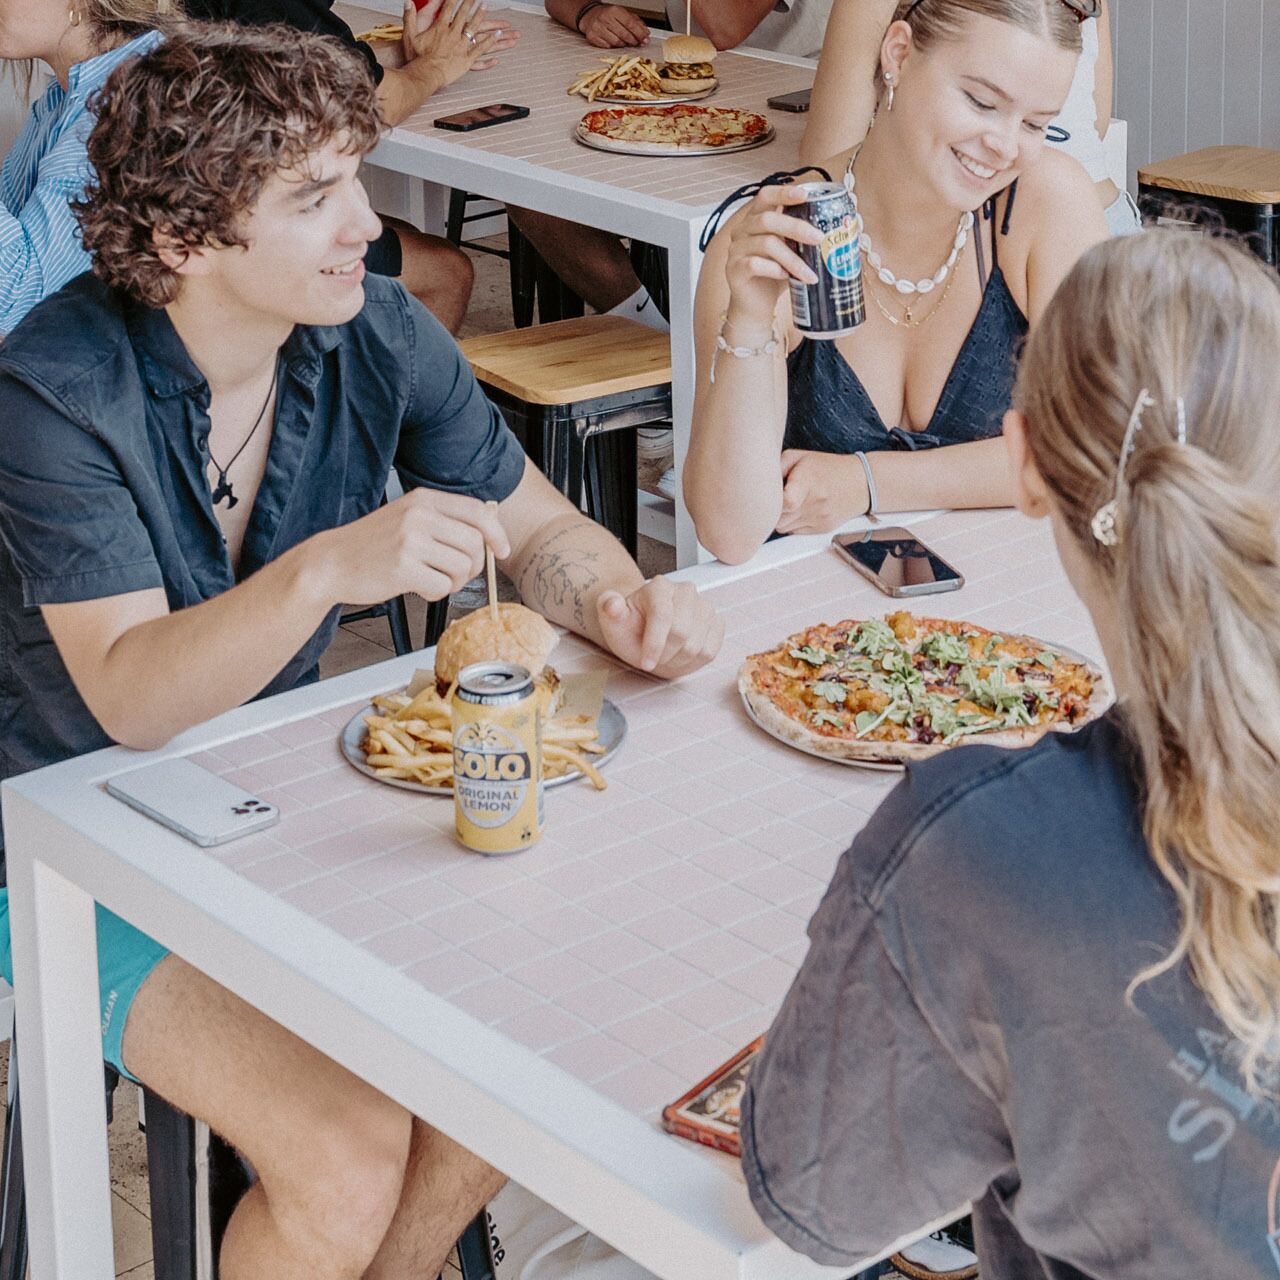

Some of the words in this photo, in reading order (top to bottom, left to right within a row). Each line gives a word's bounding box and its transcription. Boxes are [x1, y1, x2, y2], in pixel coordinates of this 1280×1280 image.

[454, 751, 526, 781] SOLO
[458, 784, 519, 802] ORIGINAL
[464, 797, 512, 812] LEMON
